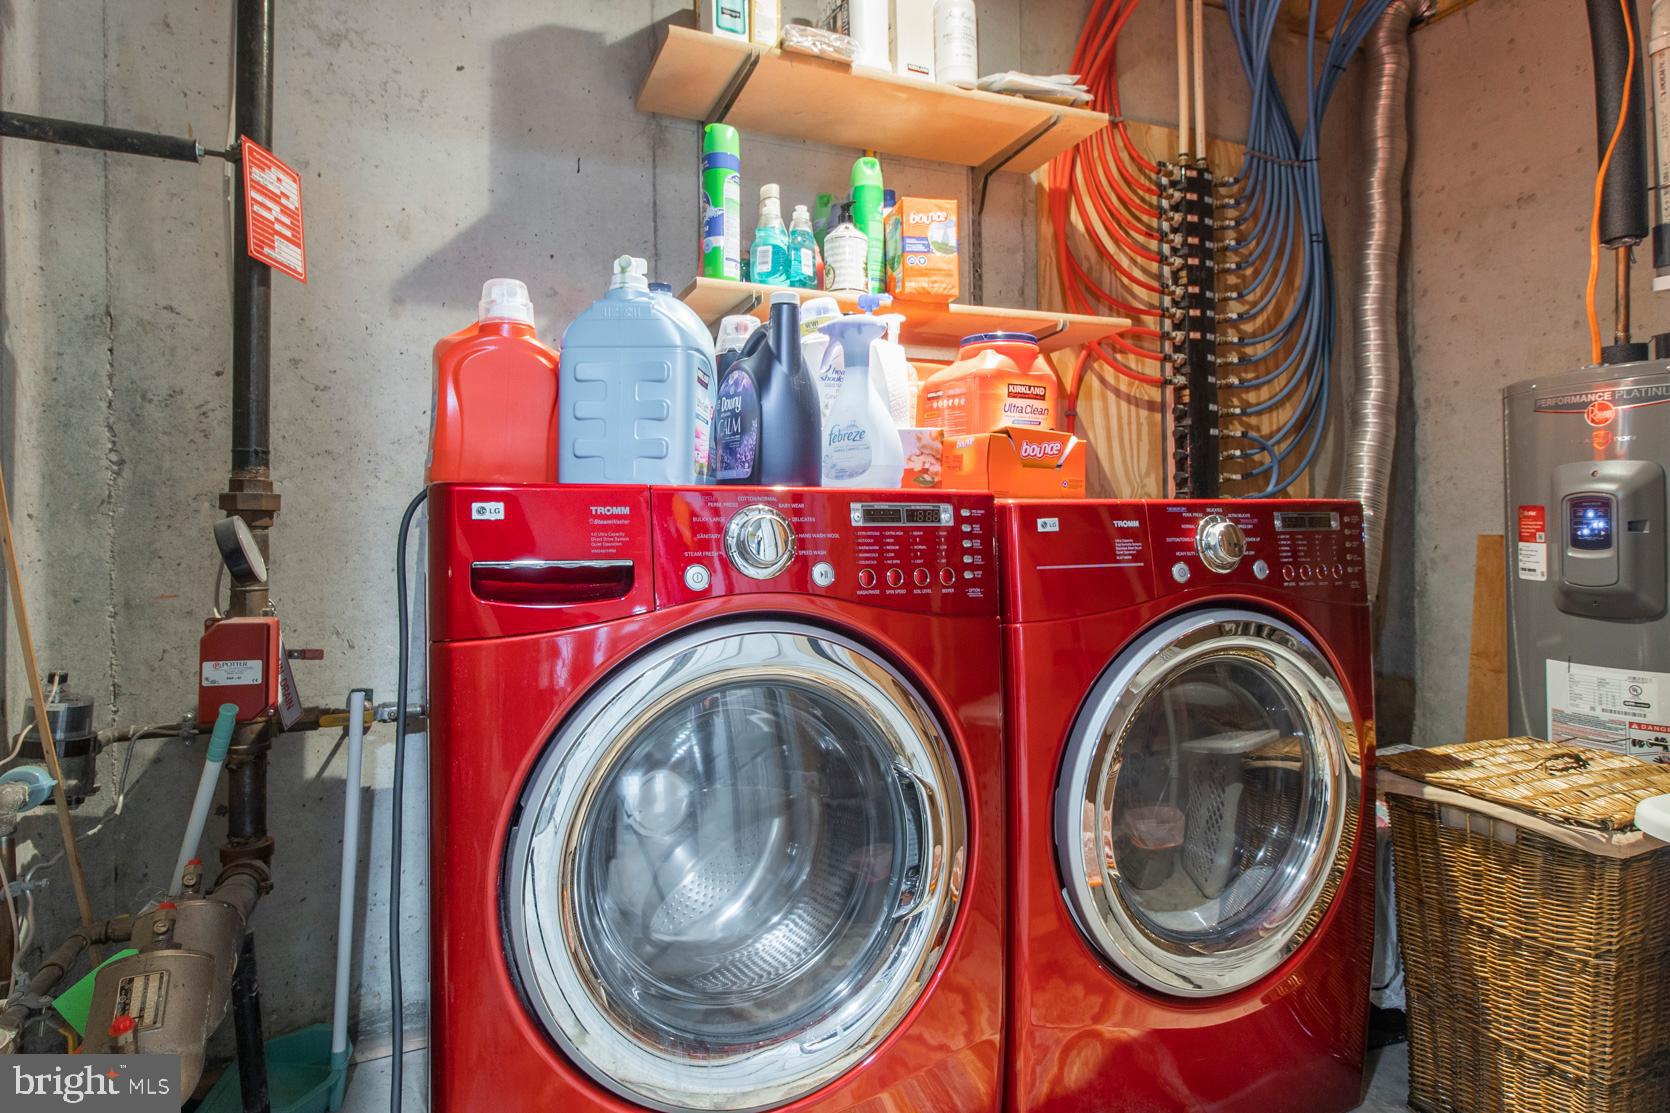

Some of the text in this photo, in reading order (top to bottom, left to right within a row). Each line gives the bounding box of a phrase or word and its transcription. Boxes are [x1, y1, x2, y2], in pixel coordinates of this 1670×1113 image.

[910, 211, 947, 224] bounce
[1009, 385, 1045, 395] KIRKLAND
[1536, 386, 1670, 408] PERFORMANCE PLATINU
[721, 396, 742, 413] Downy
[1003, 403, 1049, 415] Ultra Clean
[829, 424, 866, 447] febreze
[1021, 441, 1061, 458] bounce
[590, 506, 630, 515] TROMM
[1113, 520, 1139, 528] TROMM
[280, 677, 295, 711] DRAIN
